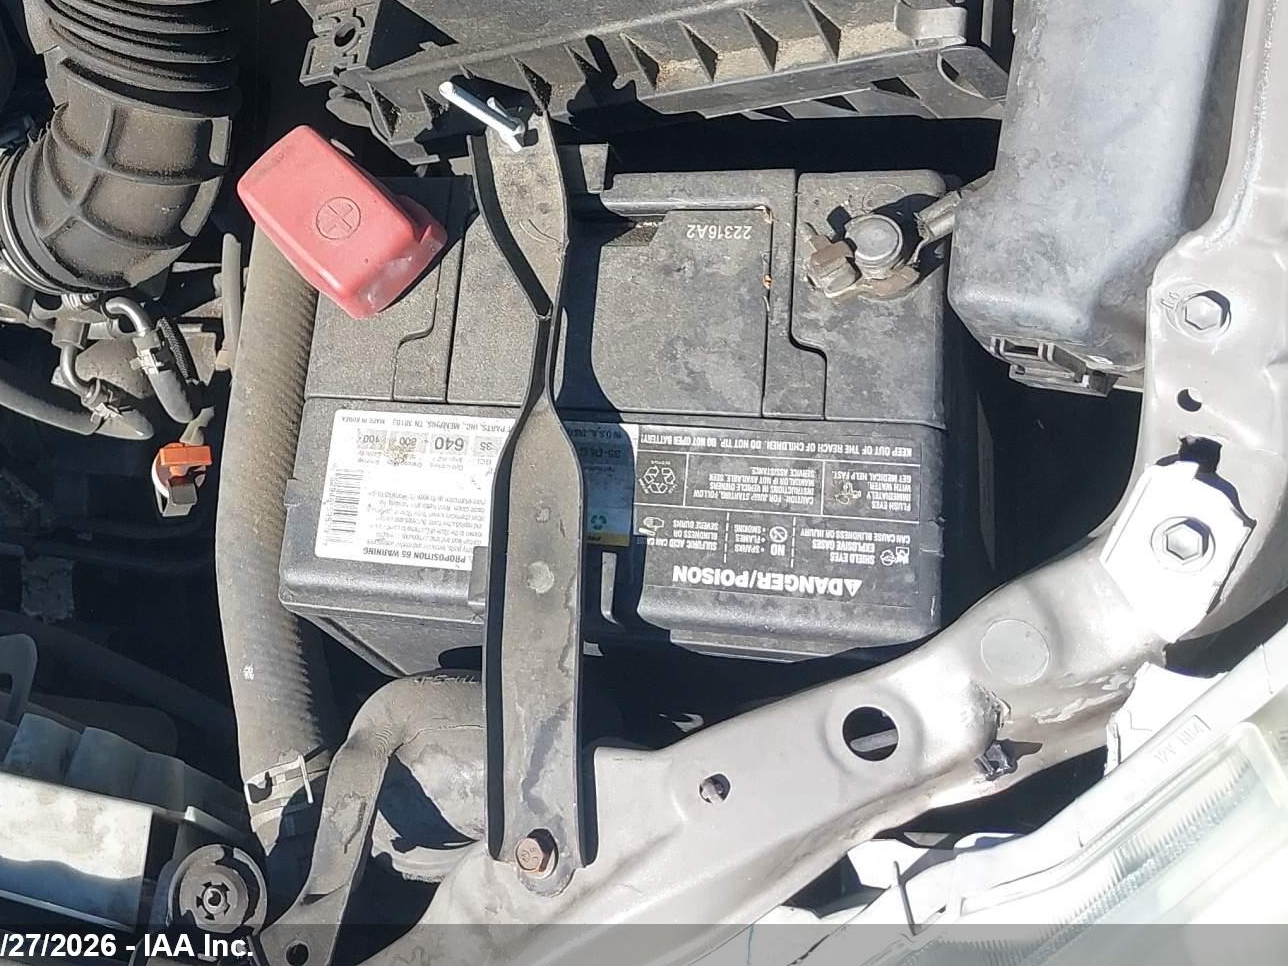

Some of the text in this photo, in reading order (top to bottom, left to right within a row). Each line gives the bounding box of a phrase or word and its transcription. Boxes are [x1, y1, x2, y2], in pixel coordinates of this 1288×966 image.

[686, 224, 752, 240] 22316A2
[415, 420, 424, 428] TN
[426, 420, 460, 430] MEMPHIS,
[480, 424, 506, 433] PARTS,
[434, 437, 464, 452] 640
[641, 434, 672, 445] BATTERY!
[673, 436, 691, 446] OPEN
[693, 436, 706, 446] NOT
[706, 437, 717, 448] DO
[720, 438, 732, 449] TIP.
[733, 439, 750, 450] NOT
[479, 441, 493, 451] 35
[751, 440, 762, 450] DO
[805, 442, 816, 452] OF
[818, 443, 843, 454] REACH
[844, 444, 860, 455] THE
[862, 445, 873, 455] OF
[875, 446, 891, 457] OUT
[892, 447, 912, 458] KEEP
[709, 474, 724, 483] SEEK
[790, 469, 815, 479] SERVICE
[831, 470, 912, 484] GET MEDICAL HELP FAST.
[759, 476, 772, 485] NOT
[773, 476, 780, 485] IF
[780, 477, 789, 485] OR
[789, 477, 814, 487] MANUAL
[736, 483, 761, 493] VEHICLE
[761, 484, 768, 493] IN
[769, 485, 815, 495] INSTRUCTIONS
[893, 483, 912, 493] WITH
[693, 489, 718, 499] FOLLOW
[751, 493, 768, 502] JUMP
[769, 494, 782, 502] FOR
[866, 491, 912, 502] IMMEDIATELY
[872, 500, 912, 512] FLUSH EYES
[673, 519, 718, 532] SEVERE BURNS
[734, 524, 762, 534] SMOKING
[673, 529, 718, 540] BLINDNESS OR
[735, 534, 761, 544] FLAMES
[800, 528, 911, 544] CAN CAUSE BLINDNESS OR INJURY
[655, 538, 668, 546] CAN
[669, 538, 685, 548] ACID
[686, 540, 718, 551] SULFURIC
[835, 541, 876, 553] EXPLOSIVE
[734, 544, 761, 553] SPARKS
[770, 544, 786, 556] NO
[363, 547, 467, 564] PROPOSITION 65 WARNING
[829, 551, 876, 565] SHIELD EYES
[673, 564, 844, 596] DANGER/POISON
